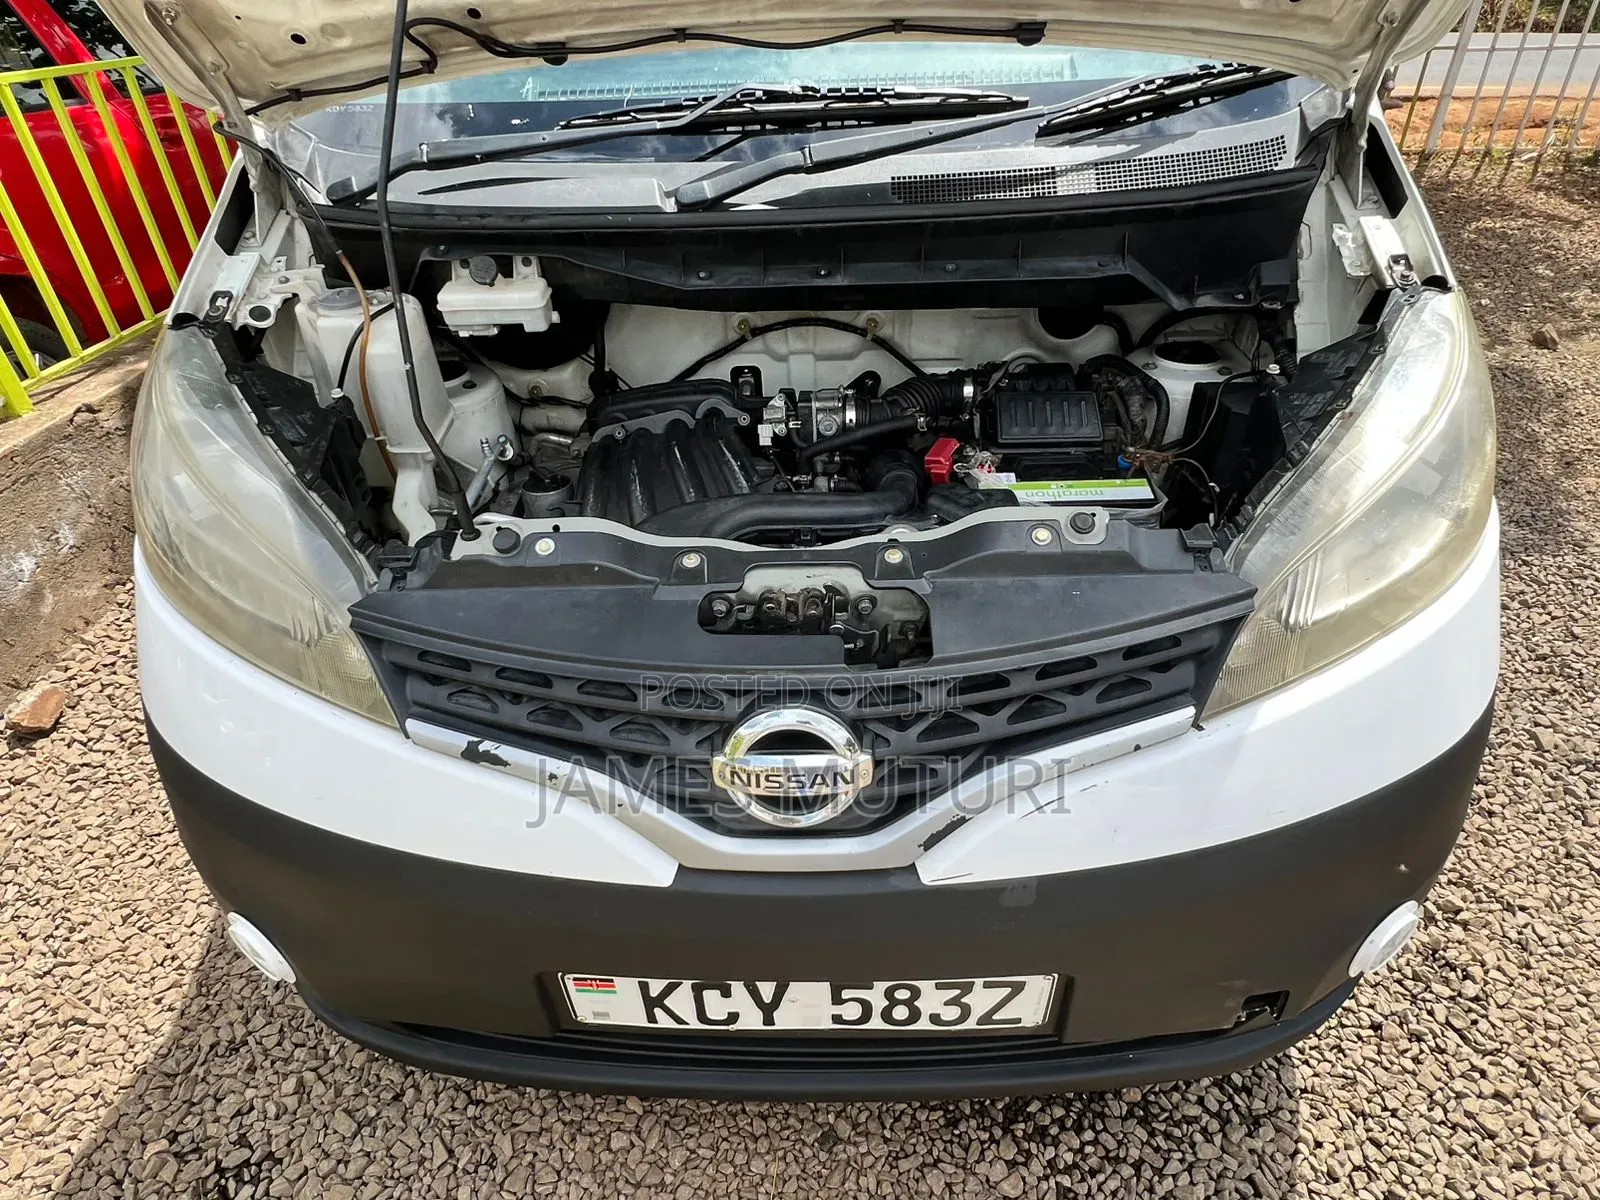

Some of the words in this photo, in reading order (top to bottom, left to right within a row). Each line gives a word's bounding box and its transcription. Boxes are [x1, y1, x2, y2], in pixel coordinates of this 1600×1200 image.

[1025, 489, 1104, 500] marathon
[729, 768, 856, 790] NISSAN
[637, 980, 790, 1027] KCY
[830, 980, 1027, 1027] 583Z
